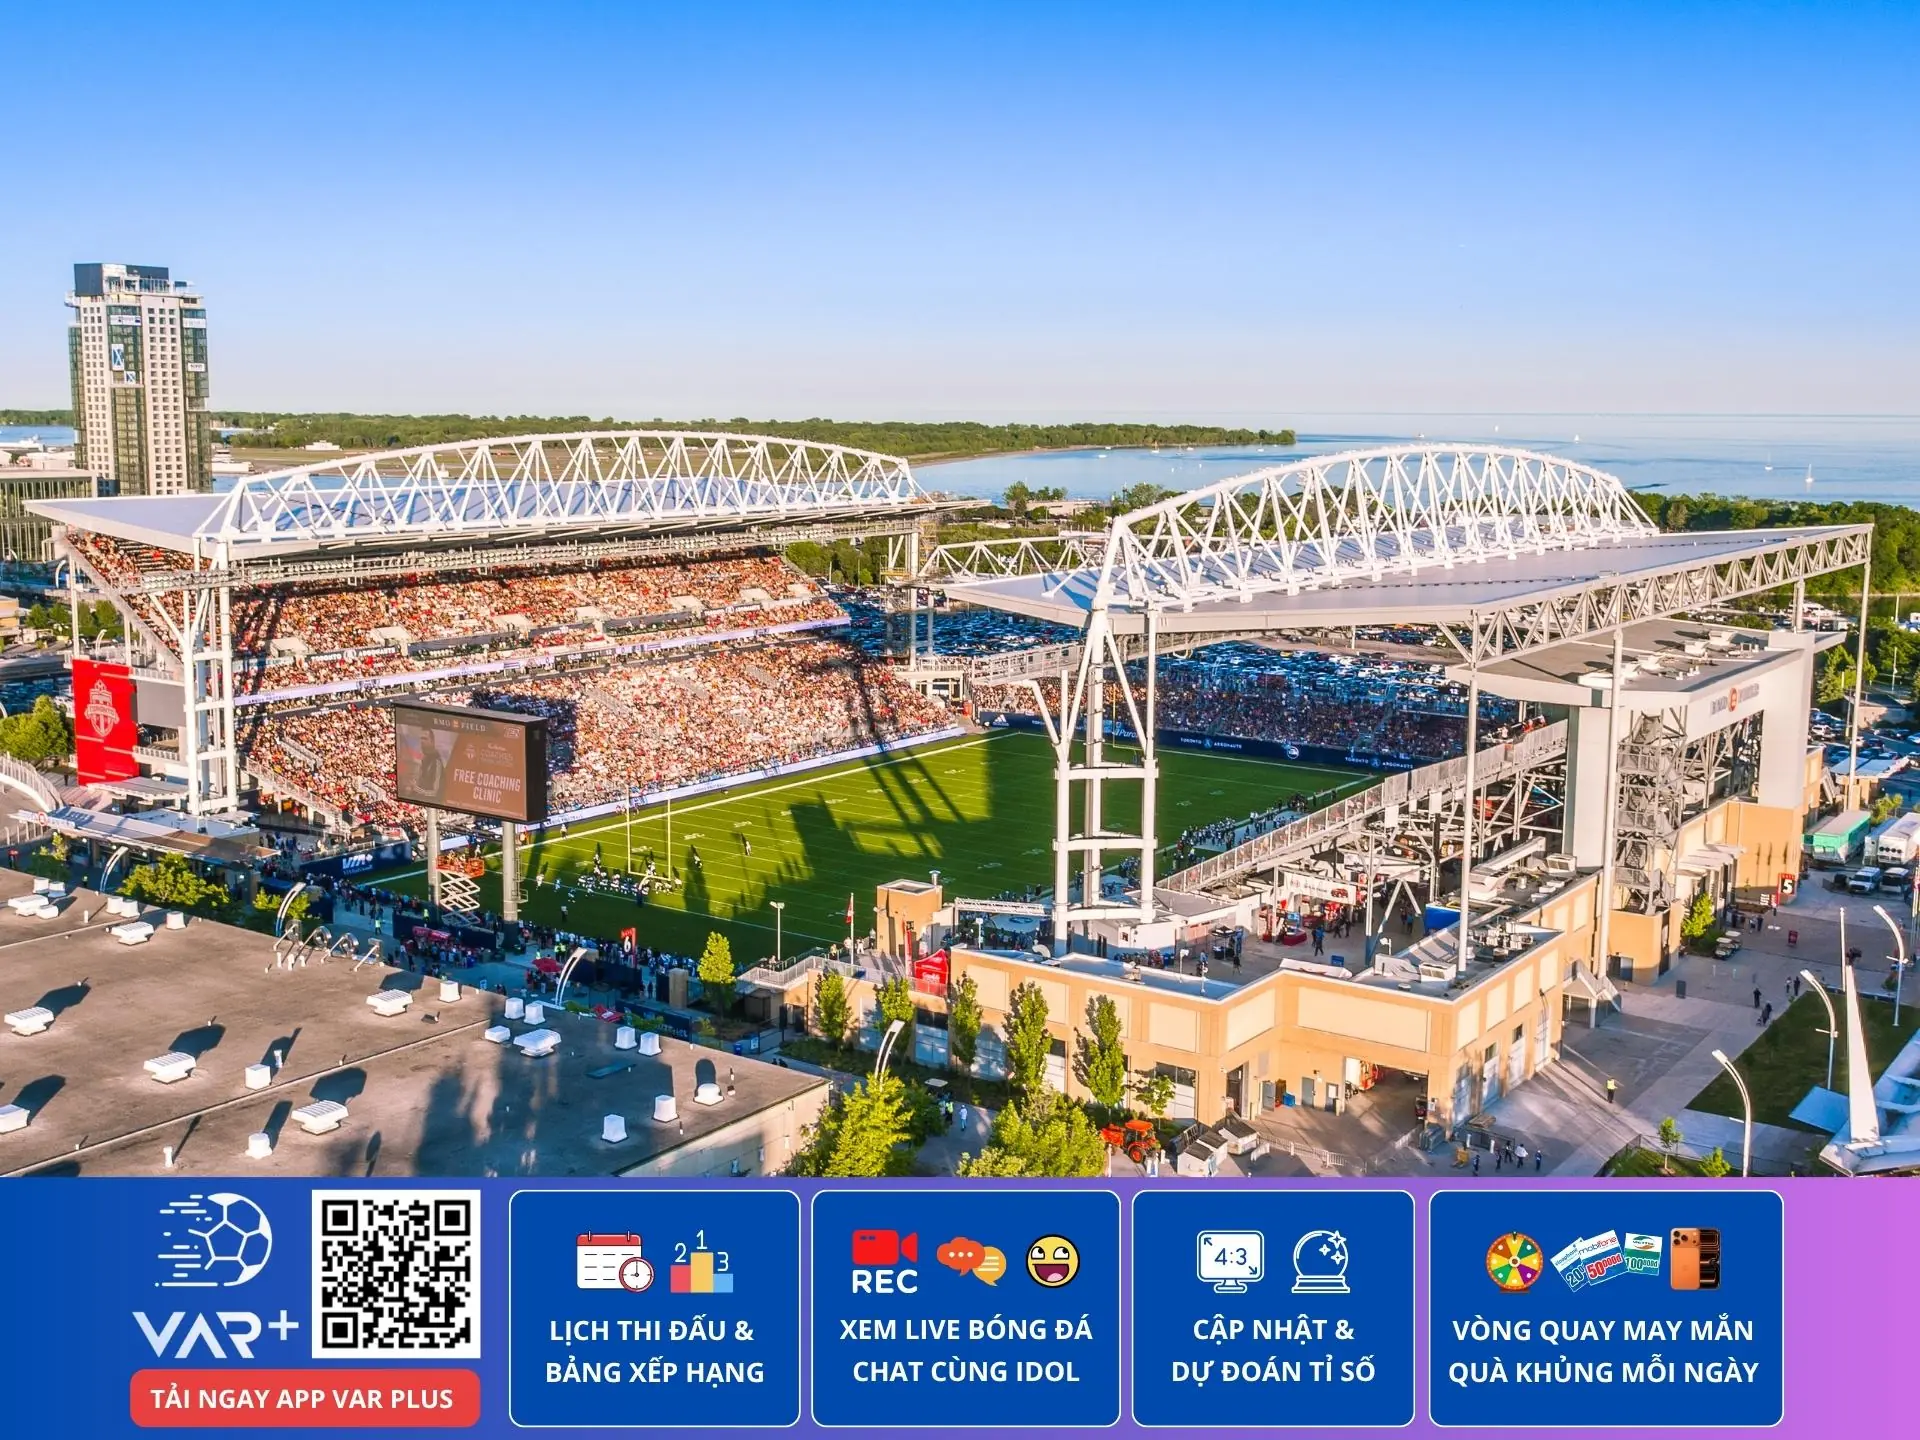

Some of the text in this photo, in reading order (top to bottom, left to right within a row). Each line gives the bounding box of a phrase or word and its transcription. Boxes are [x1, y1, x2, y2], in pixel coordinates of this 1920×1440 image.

[454, 768, 521, 793] FREE COACHING
[472, 786, 502, 804] CLINIC
[1782, 878, 1793, 894] 5
[624, 935, 632, 953] 6
